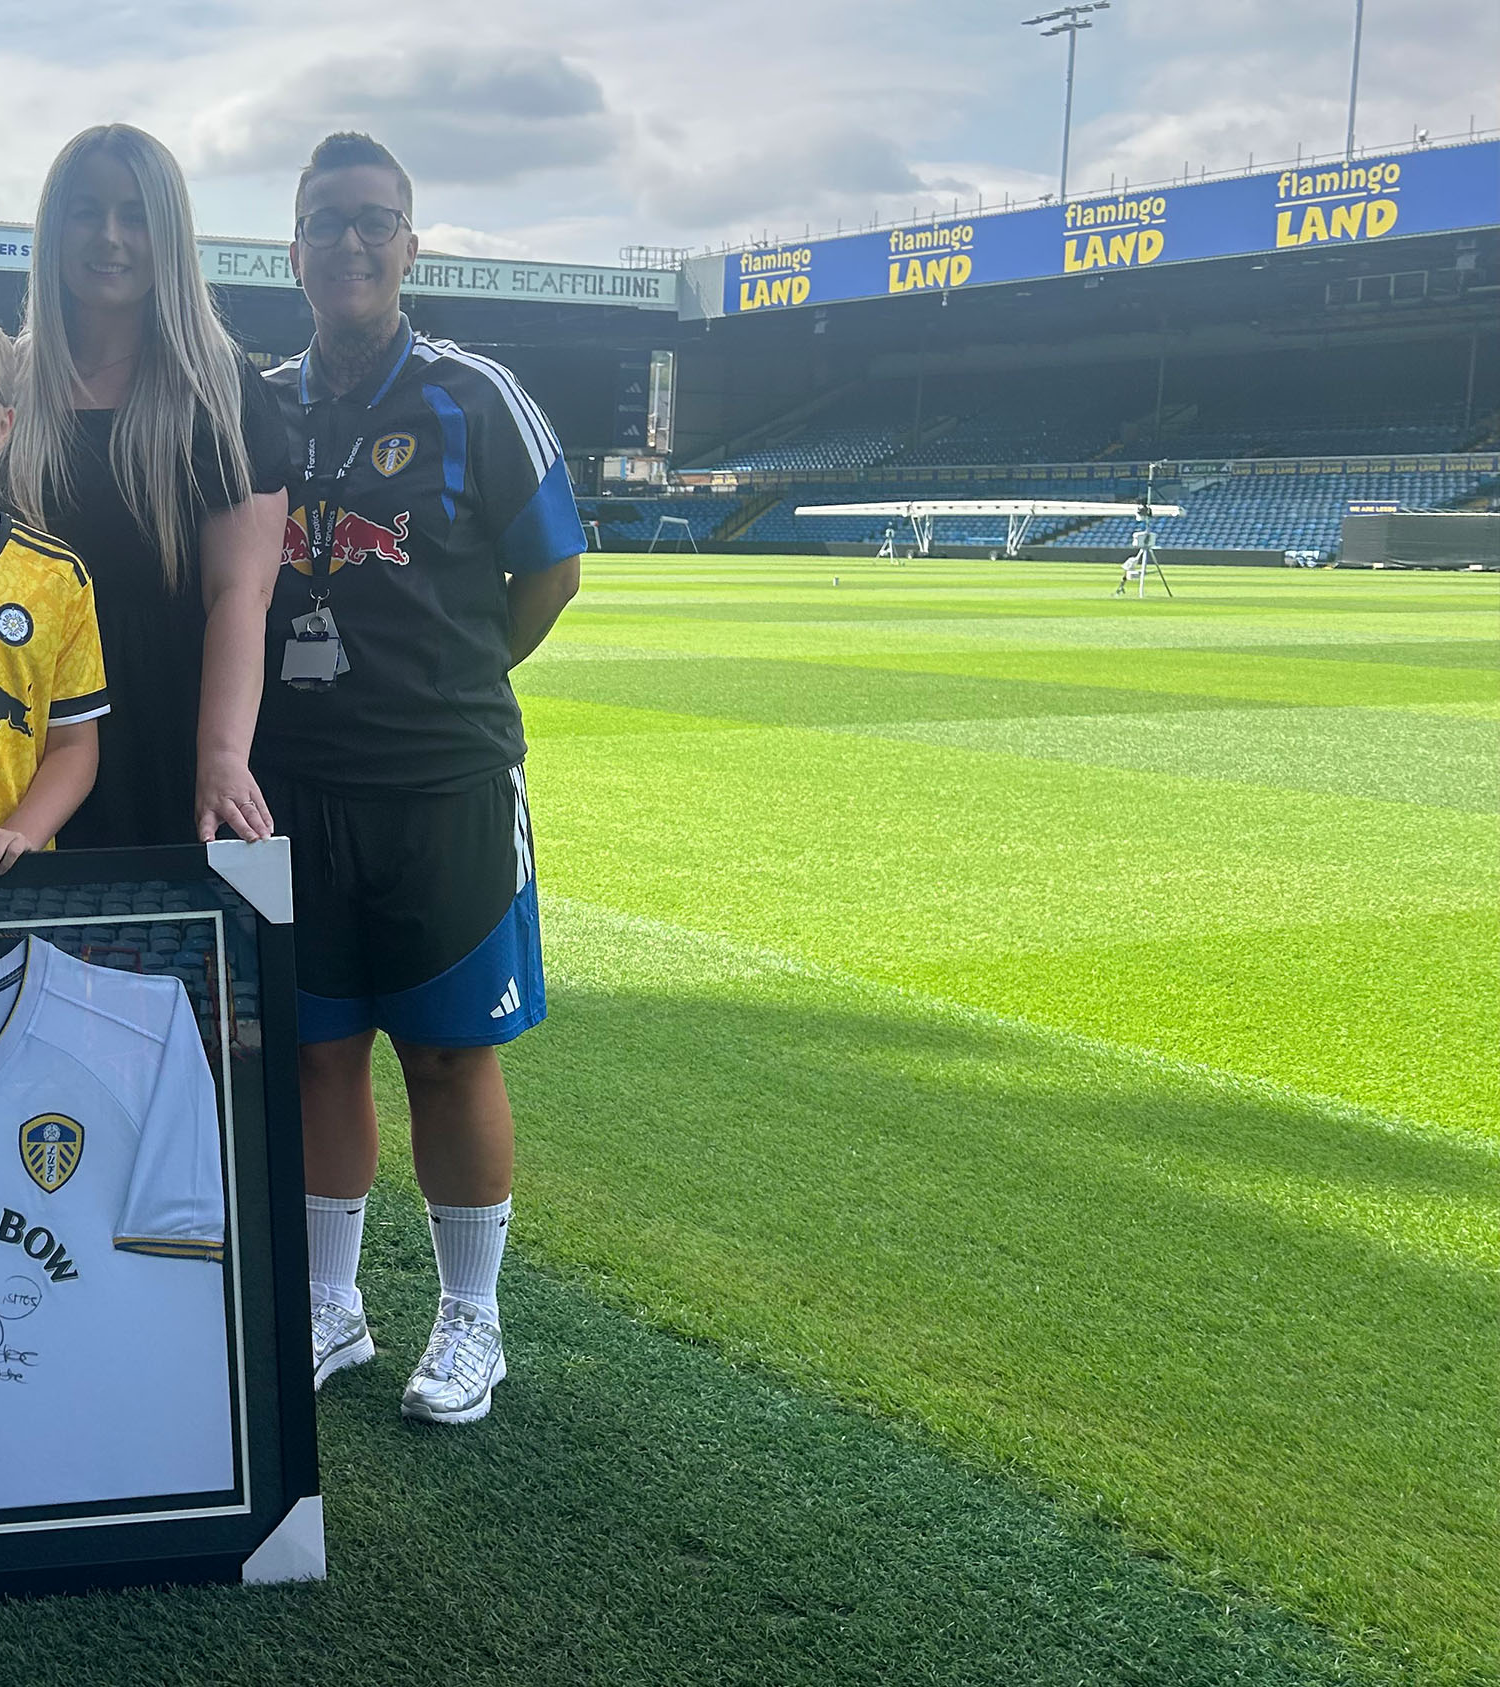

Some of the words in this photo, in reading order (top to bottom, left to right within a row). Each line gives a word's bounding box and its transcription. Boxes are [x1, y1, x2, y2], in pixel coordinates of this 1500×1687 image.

[1278, 162, 1400, 199] flamingo
[1065, 196, 1167, 228] flamingo
[1276, 199, 1398, 248] LAND
[889, 224, 975, 251] flamingo
[1064, 229, 1165, 273] LAND
[740, 248, 812, 273] flamingo
[889, 255, 973, 293] LAND
[511, 270, 660, 299] SCAFFOLDING
[740, 276, 811, 311] LAND
[307, 438, 316, 469] Fanatics
[343, 437, 364, 468] Fanatics
[312, 509, 321, 546] Fanatics
